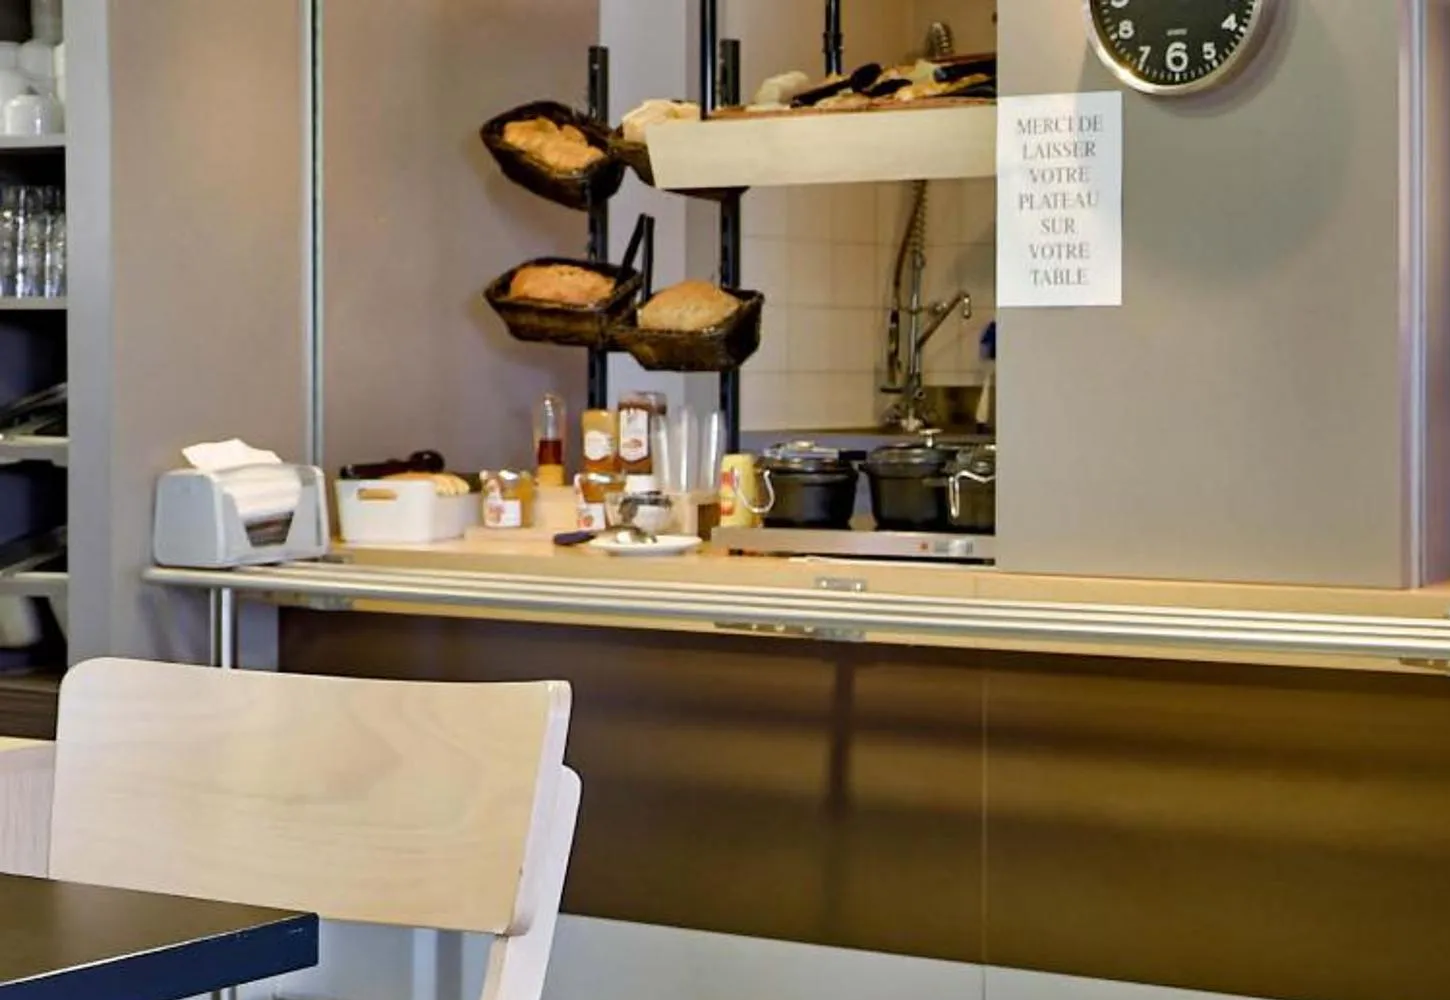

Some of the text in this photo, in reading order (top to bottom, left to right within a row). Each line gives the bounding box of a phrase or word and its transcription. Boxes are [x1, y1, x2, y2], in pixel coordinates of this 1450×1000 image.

[1118, 19, 1135, 39] 8
[1221, 13, 1238, 31] 4
[1138, 46, 1152, 71] 7
[1165, 41, 1189, 73] 6
[1202, 42, 1216, 60] 5
[1017, 114, 1103, 135] MERCI DE
[1022, 140, 1096, 160] LAISSER
[1028, 166, 1090, 184] VOTRE
[1019, 190, 1099, 210] PLATEAU
[1040, 216, 1076, 234] SUR
[1028, 242, 1090, 260] VOTRE
[1030, 267, 1089, 287] TABLE
